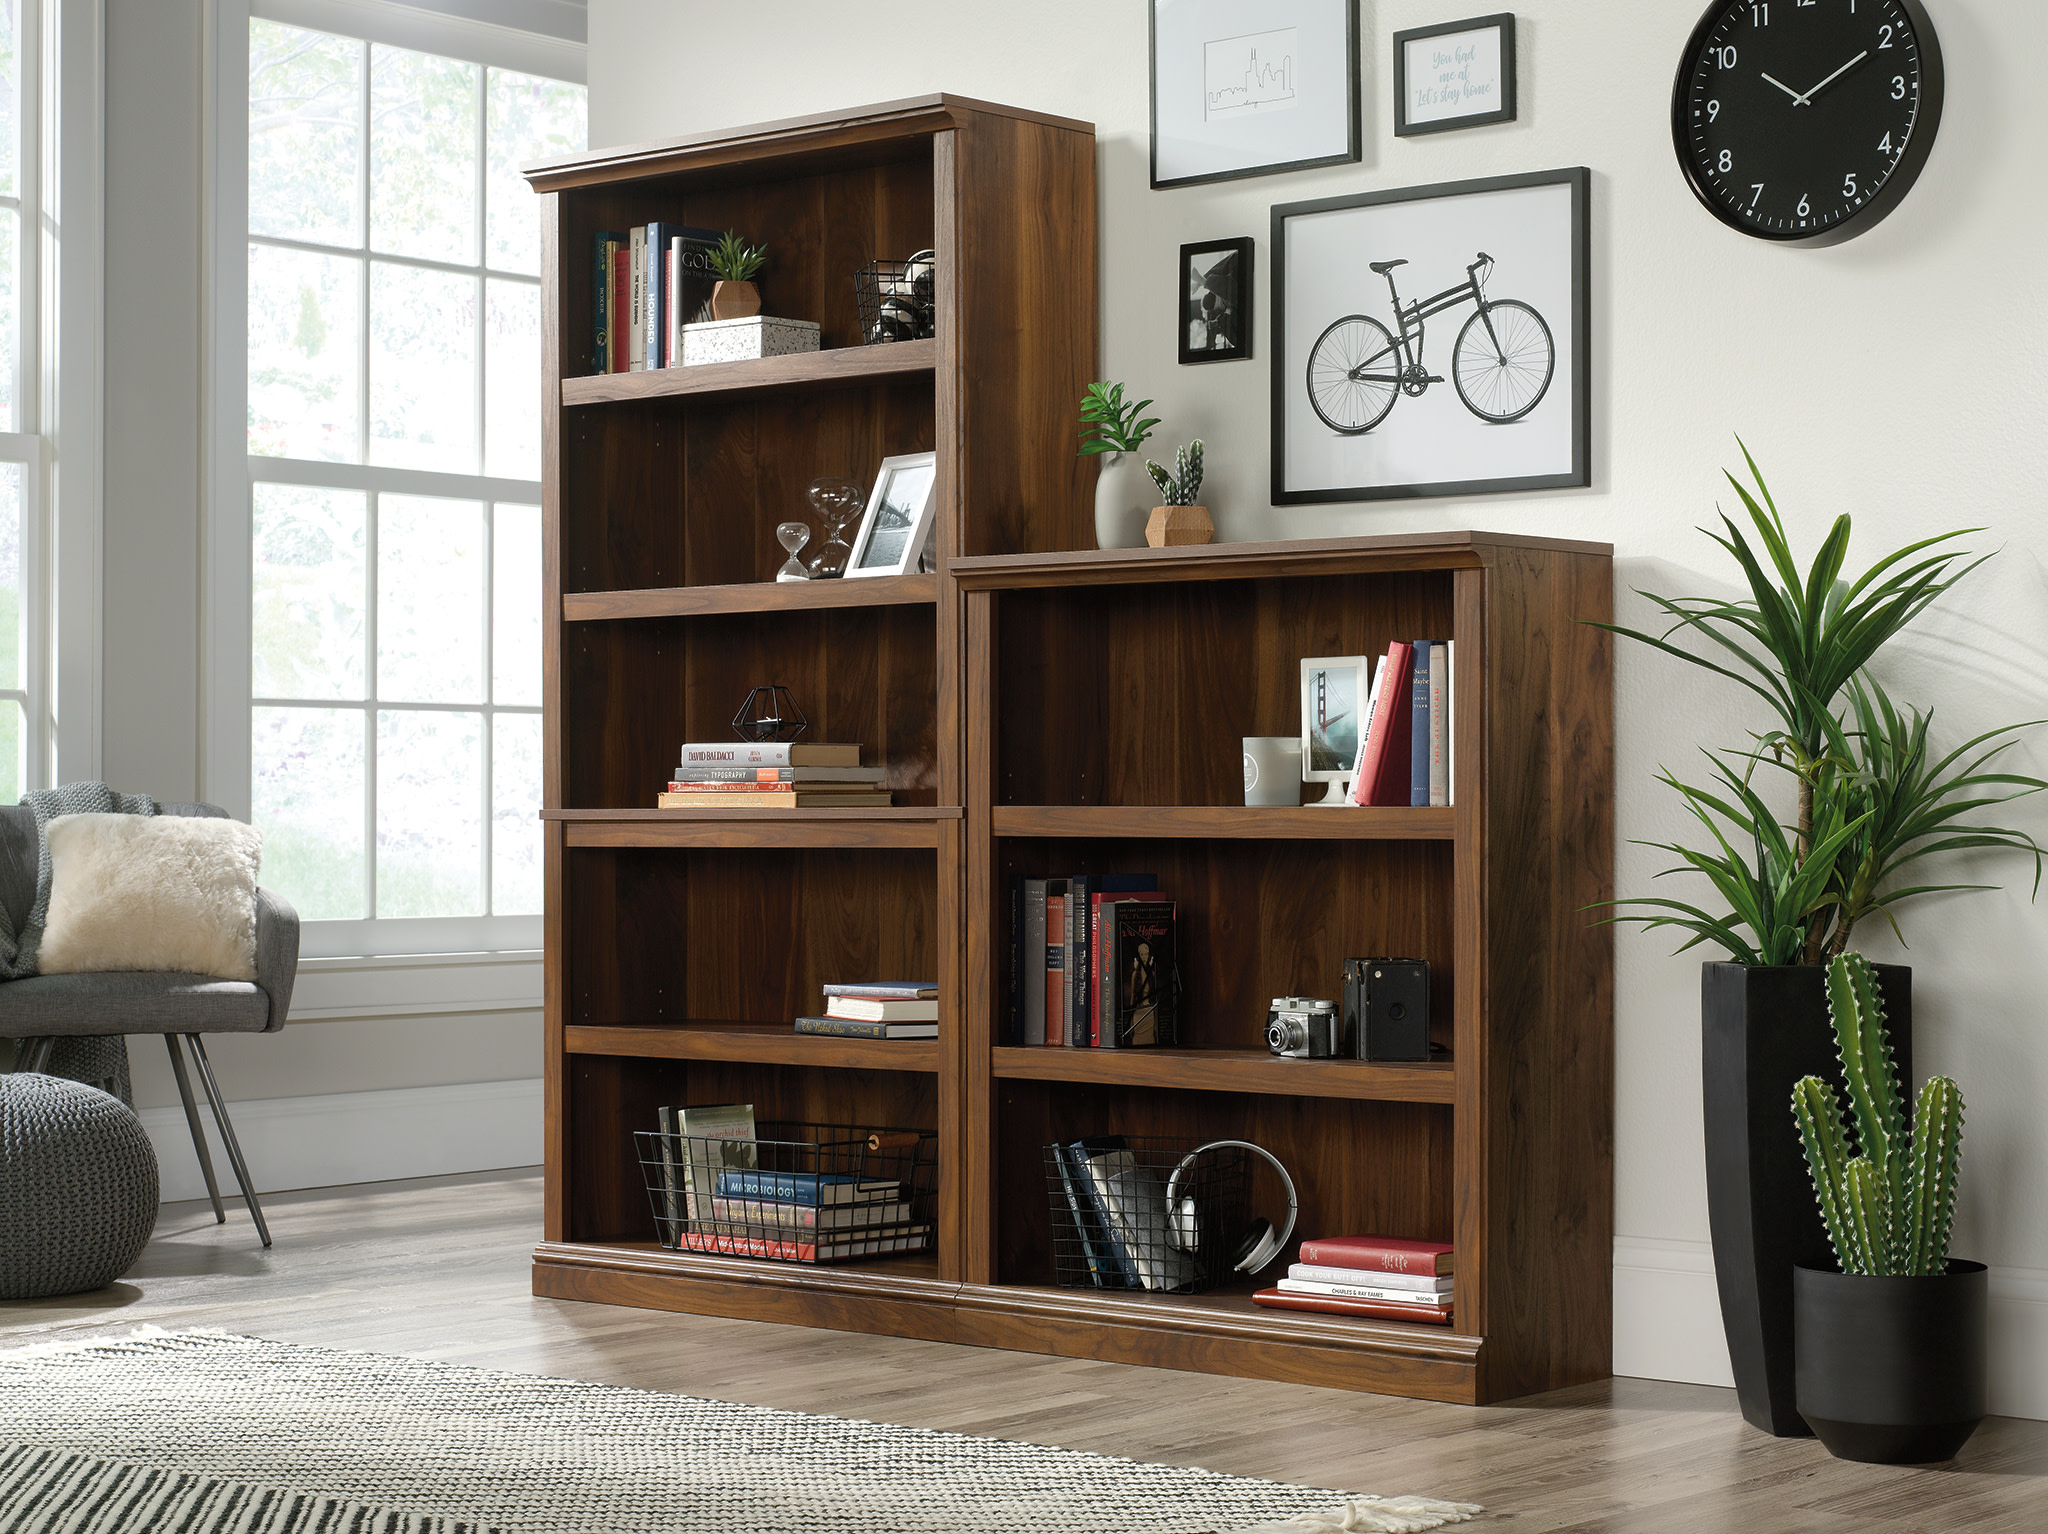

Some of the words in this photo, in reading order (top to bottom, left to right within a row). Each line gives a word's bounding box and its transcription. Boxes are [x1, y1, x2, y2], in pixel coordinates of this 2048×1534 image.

[1751, 3, 1769, 27] 11
[1878, 24, 1893, 50] 2
[1432, 51, 1452, 70] You
[1455, 44, 1475, 64] had
[1715, 45, 1738, 70] 10
[1439, 71, 1456, 83] me
[1457, 63, 1471, 80] at
[1439, 84, 1460, 106] stay
[1890, 75, 1906, 100] 3
[1706, 99, 1720, 123] 9
[1877, 130, 1892, 154] 4
[1718, 149, 1732, 173] 8
[1751, 183, 1764, 208] 7
[1842, 173, 1857, 197] 5
[1796, 193, 1810, 217] 6
[647, 293, 656, 345] HOUNDED
[688, 751, 706, 761] DAVID
[706, 751, 735, 761] BALDACCI
[711, 771, 746, 779] TYPOGRAPHY
[1104, 919, 1112, 938] Alice
[1102, 938, 1112, 973] Hoffman
[1078, 963, 1086, 981] Way
[1078, 981, 1086, 1006] Things
[801, 1020, 812, 1031] The
[716, 1128, 734, 1138] orchid
[736, 1127, 750, 1138] thief
[1296, 1270, 1313, 1278] COOK
[1314, 1271, 1332, 1279] YOUR
[1332, 1273, 1349, 1281] BUTT
[1331, 1288, 1352, 1296] CHARLES
